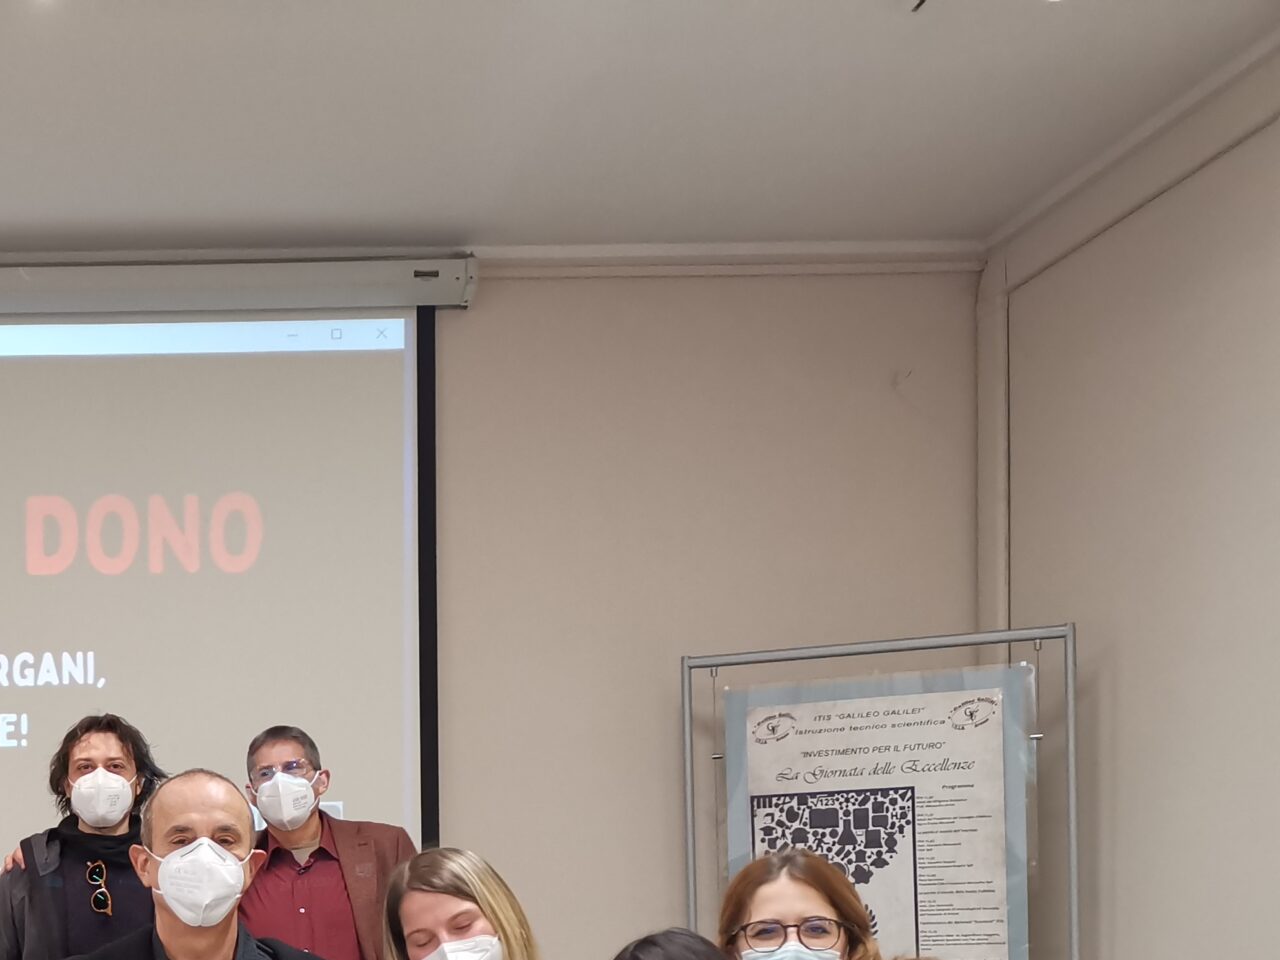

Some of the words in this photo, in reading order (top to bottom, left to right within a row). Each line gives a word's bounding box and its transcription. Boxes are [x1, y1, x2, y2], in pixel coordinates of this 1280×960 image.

[25, 492, 264, 576] DONO
[813, 713, 832, 722] ITIS
[795, 726, 845, 735] Istruzione
[849, 723, 887, 731] tecnico
[891, 718, 946, 729] scientifica
[872, 745, 891, 754] PER
[893, 744, 901, 752] IL
[775, 767, 801, 782] La
[803, 765, 866, 785] Giornata
[868, 761, 897, 776] delle
[900, 757, 976, 774] Eccellenze
